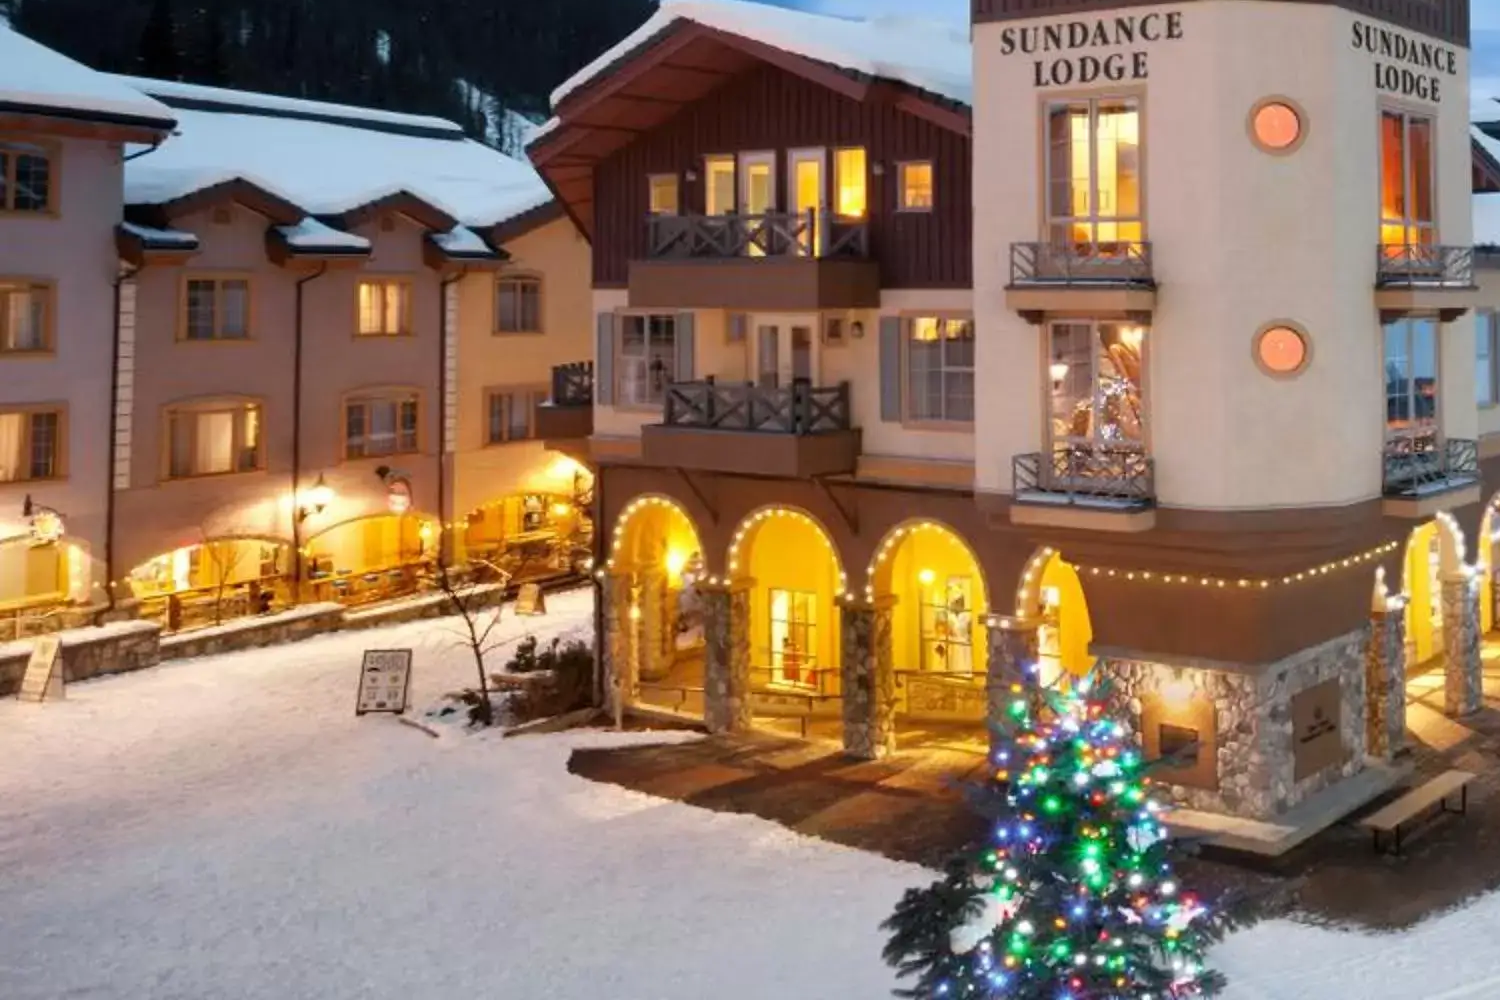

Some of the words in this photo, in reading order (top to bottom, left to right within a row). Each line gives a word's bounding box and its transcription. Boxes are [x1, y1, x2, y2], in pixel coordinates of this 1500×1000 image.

[1000, 12, 1184, 55] SUNDANCE
[1352, 20, 1457, 75] SUNDANCE
[1033, 51, 1149, 87] LODGE
[1375, 61, 1441, 103] LODGE
